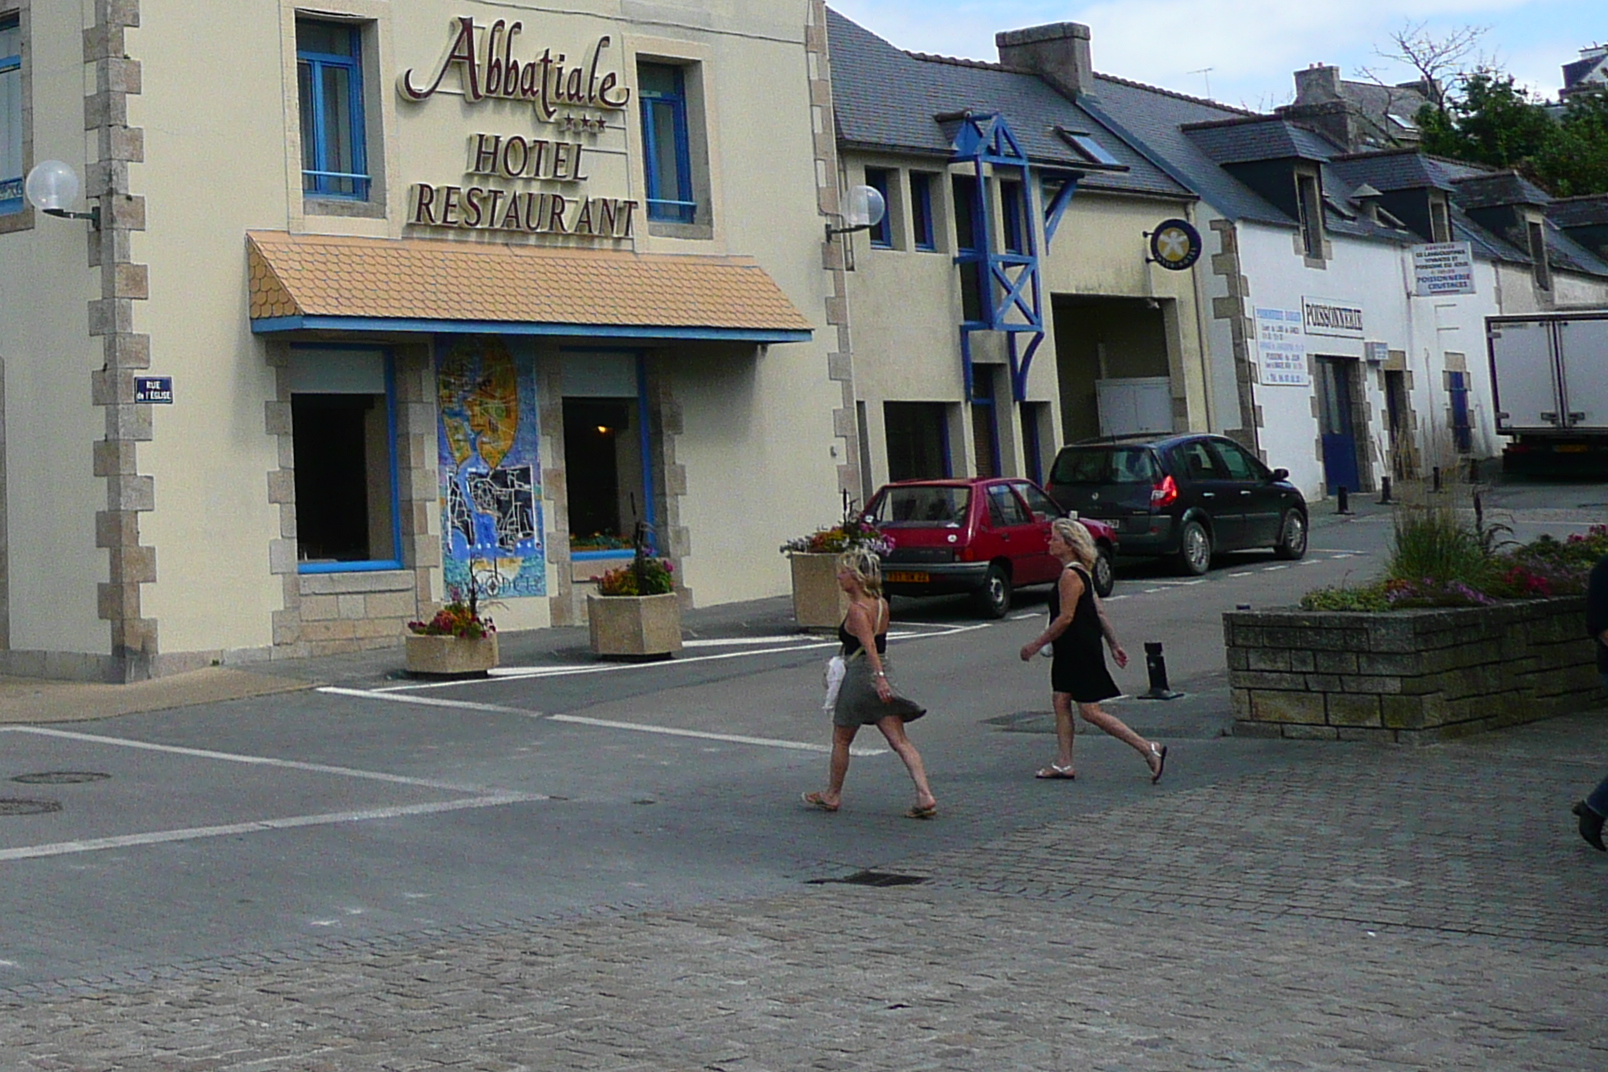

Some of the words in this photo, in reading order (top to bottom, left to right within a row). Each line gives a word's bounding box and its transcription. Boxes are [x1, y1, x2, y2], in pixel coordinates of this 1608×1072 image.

[404, 16, 631, 120] Abbatiale
[473, 133, 589, 181] HOTEL
[414, 183, 639, 238] RESTAURANT
[1305, 303, 1363, 331] POISSONNERIE
[146, 380, 161, 389] RUE
